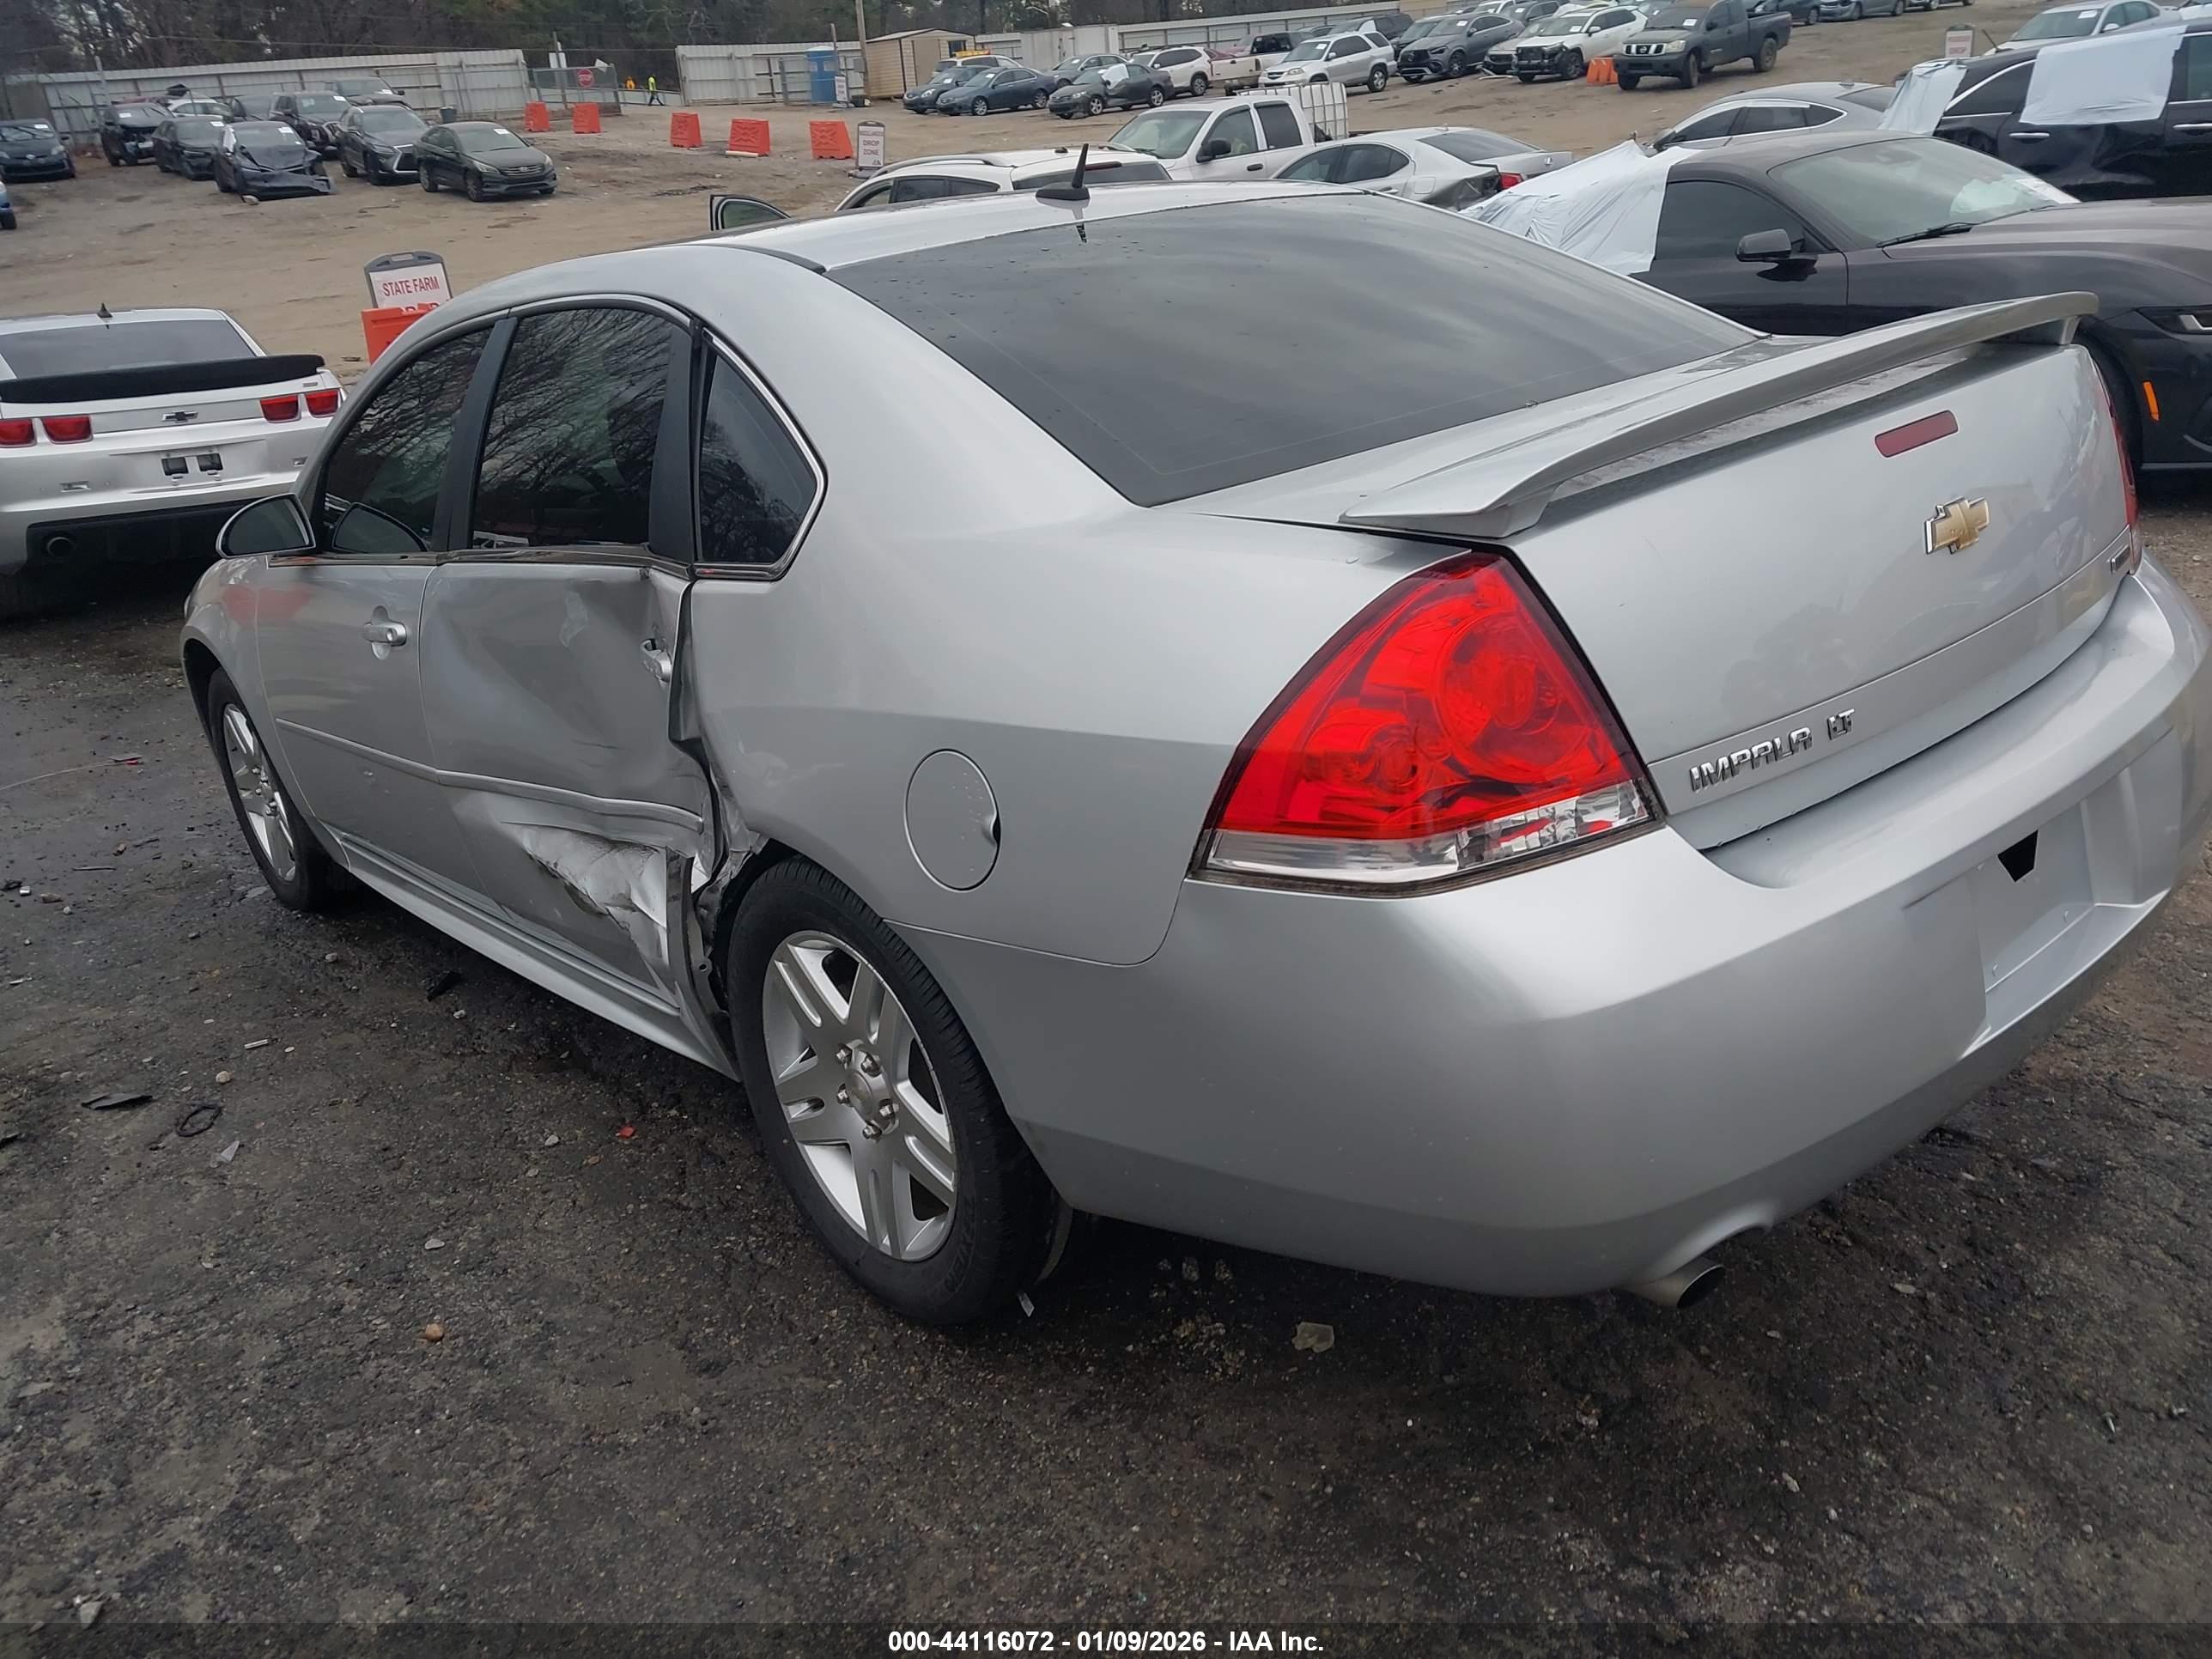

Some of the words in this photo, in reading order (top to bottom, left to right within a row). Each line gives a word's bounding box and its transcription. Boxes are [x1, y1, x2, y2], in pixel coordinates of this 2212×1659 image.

[382, 280, 413, 297] STATE
[412, 276, 440, 293] FARM
[1689, 726, 1813, 793] IMPALA
[1826, 708, 1856, 741] LT
